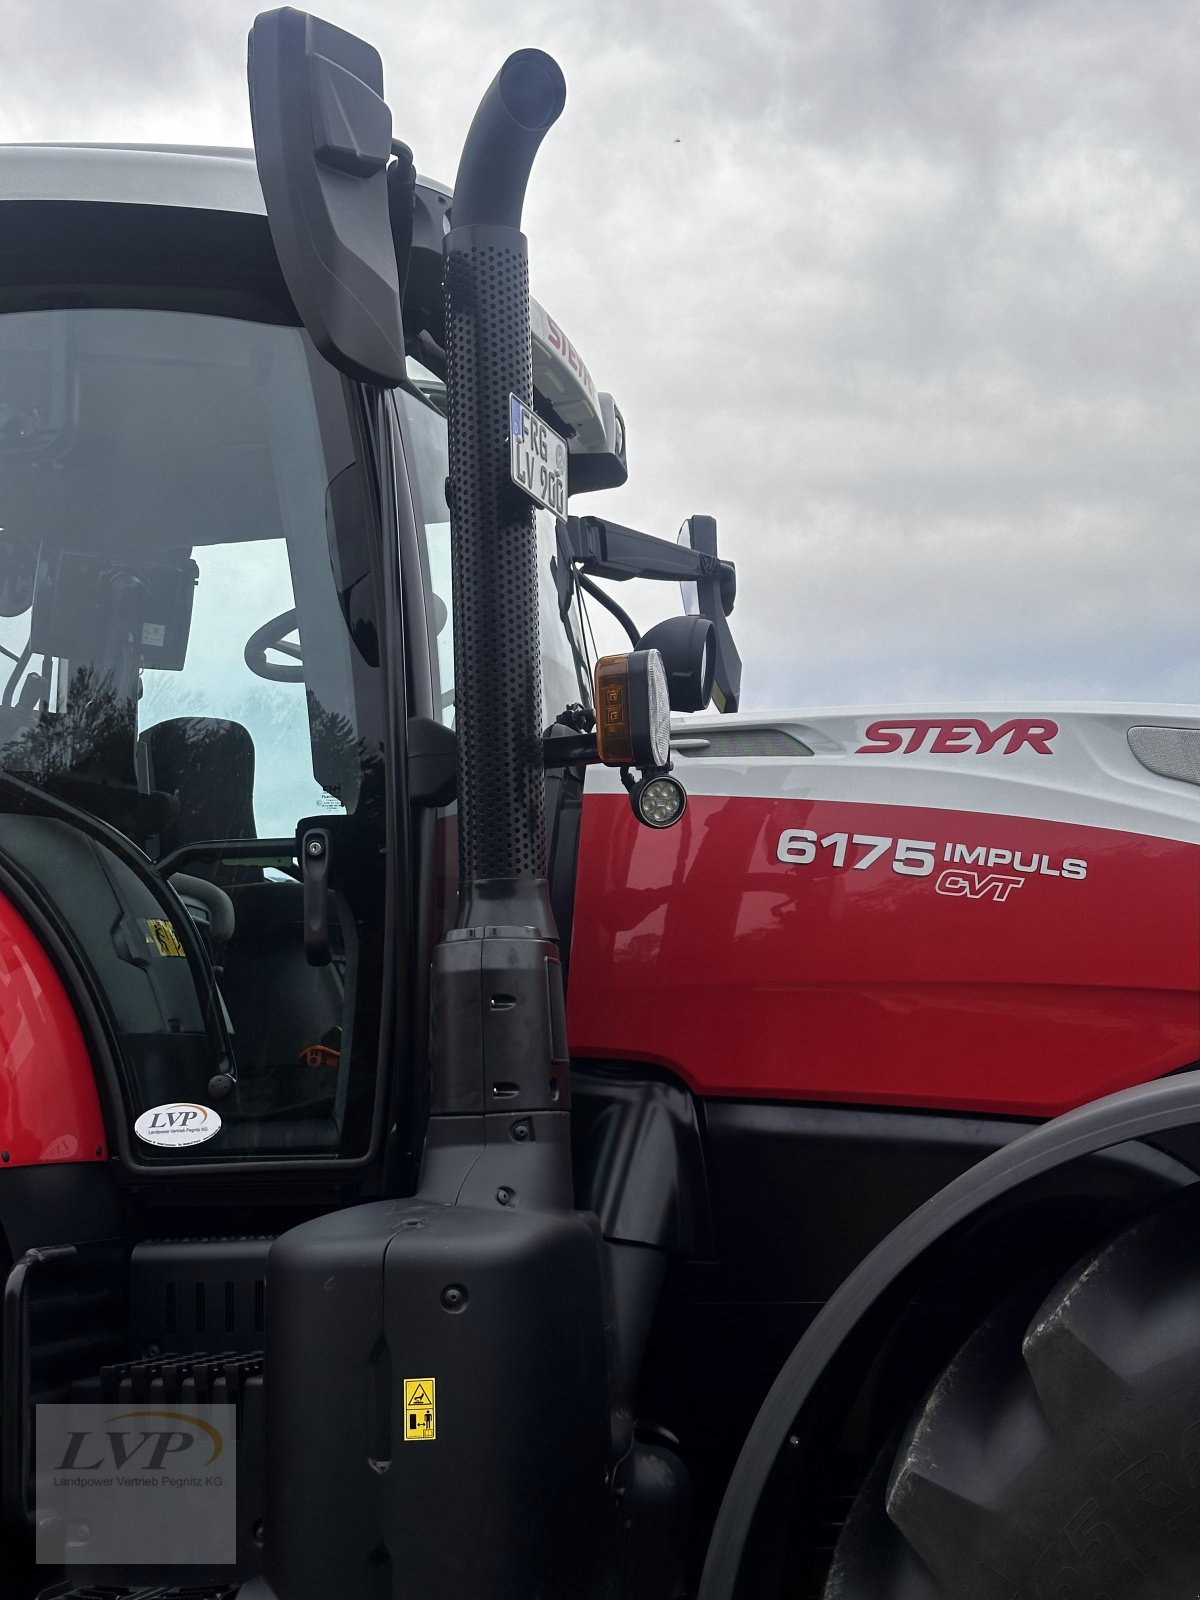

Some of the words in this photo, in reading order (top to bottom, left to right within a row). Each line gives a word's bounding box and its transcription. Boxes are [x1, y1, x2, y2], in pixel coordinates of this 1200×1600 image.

[547, 314, 593, 396] STEYR
[522, 408, 548, 463] FRG
[516, 443, 535, 490] LV
[540, 465, 564, 515] 900
[854, 718, 1059, 755] STEYR
[776, 828, 937, 877] 6175
[943, 842, 1088, 880] IMPULS
[935, 869, 1025, 903] CVT
[148, 1111, 198, 1128] LVP
